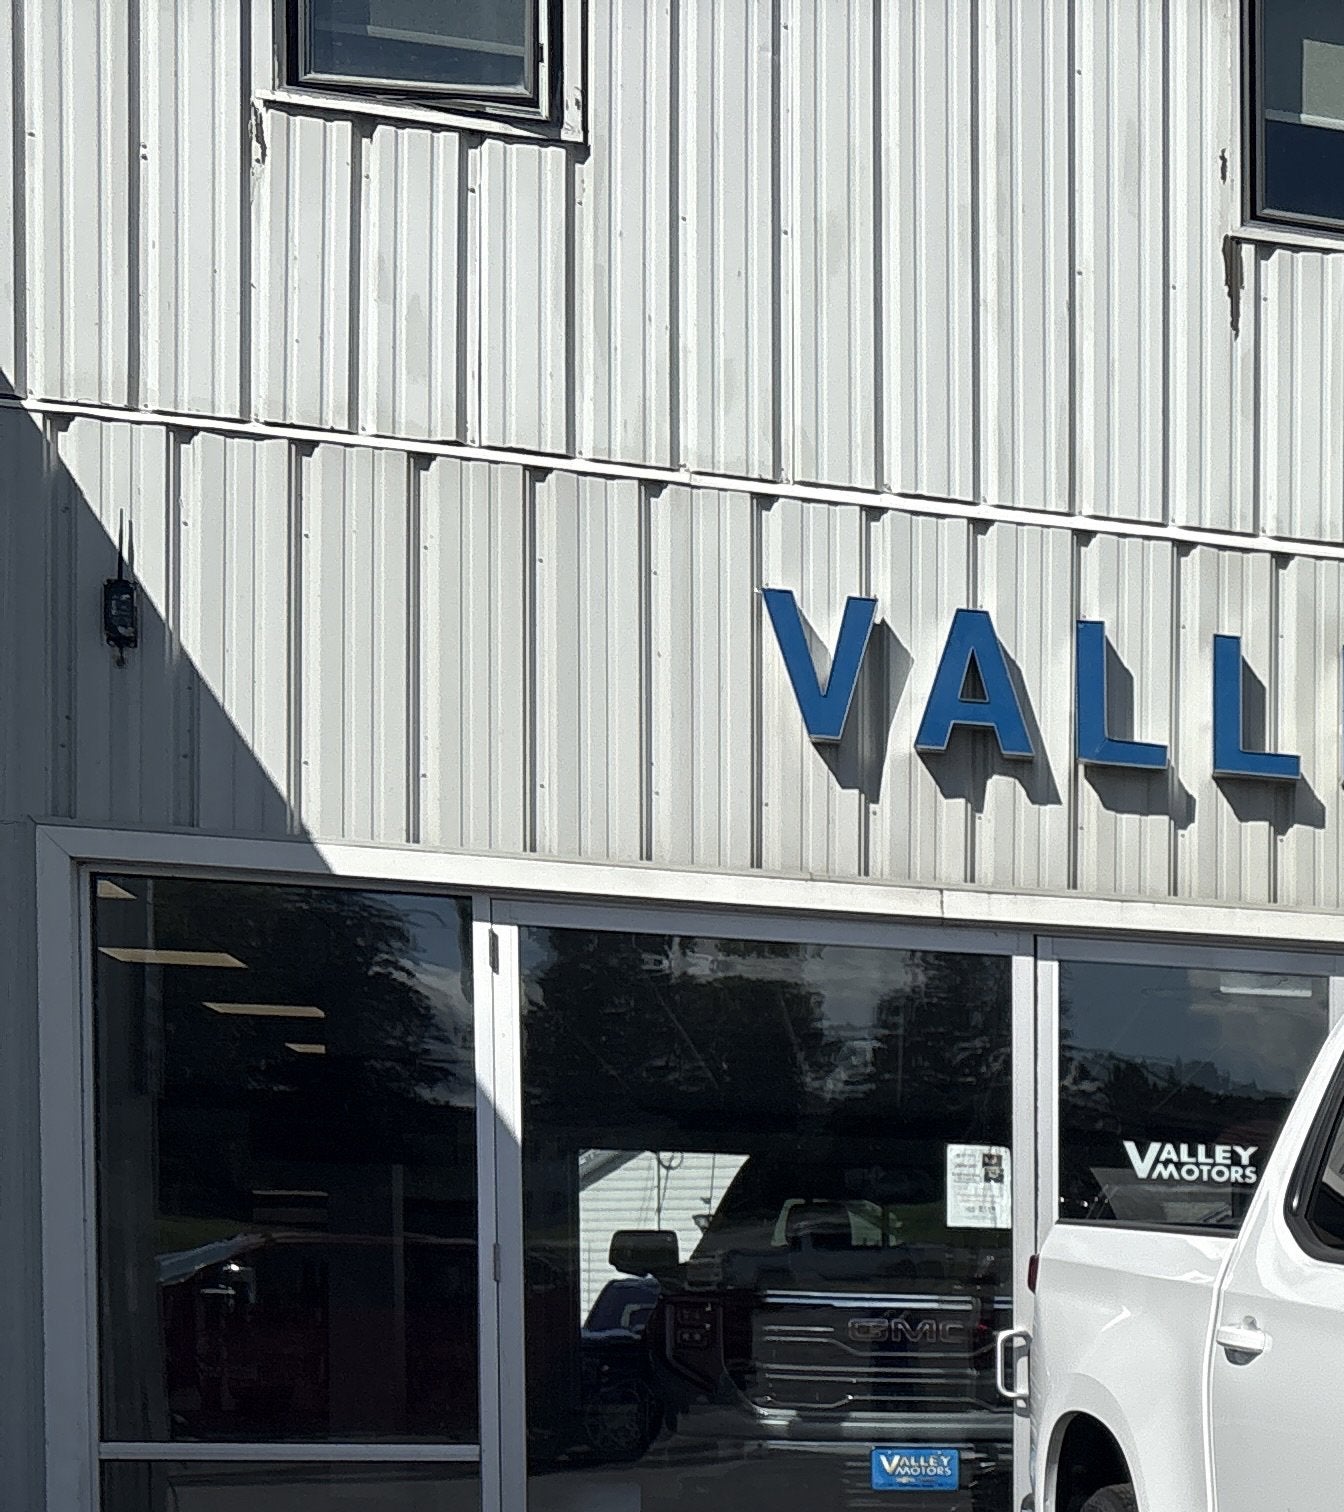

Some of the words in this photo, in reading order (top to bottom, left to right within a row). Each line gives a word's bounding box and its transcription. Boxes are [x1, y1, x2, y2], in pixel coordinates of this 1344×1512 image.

[1122, 1140, 1259, 1179] VALLEY
[1152, 1162, 1257, 1184] MOTORS
[847, 1318, 966, 1343] GMC
[880, 1454, 951, 1475] VALLEY
[895, 1465, 952, 1476] MOTORS
